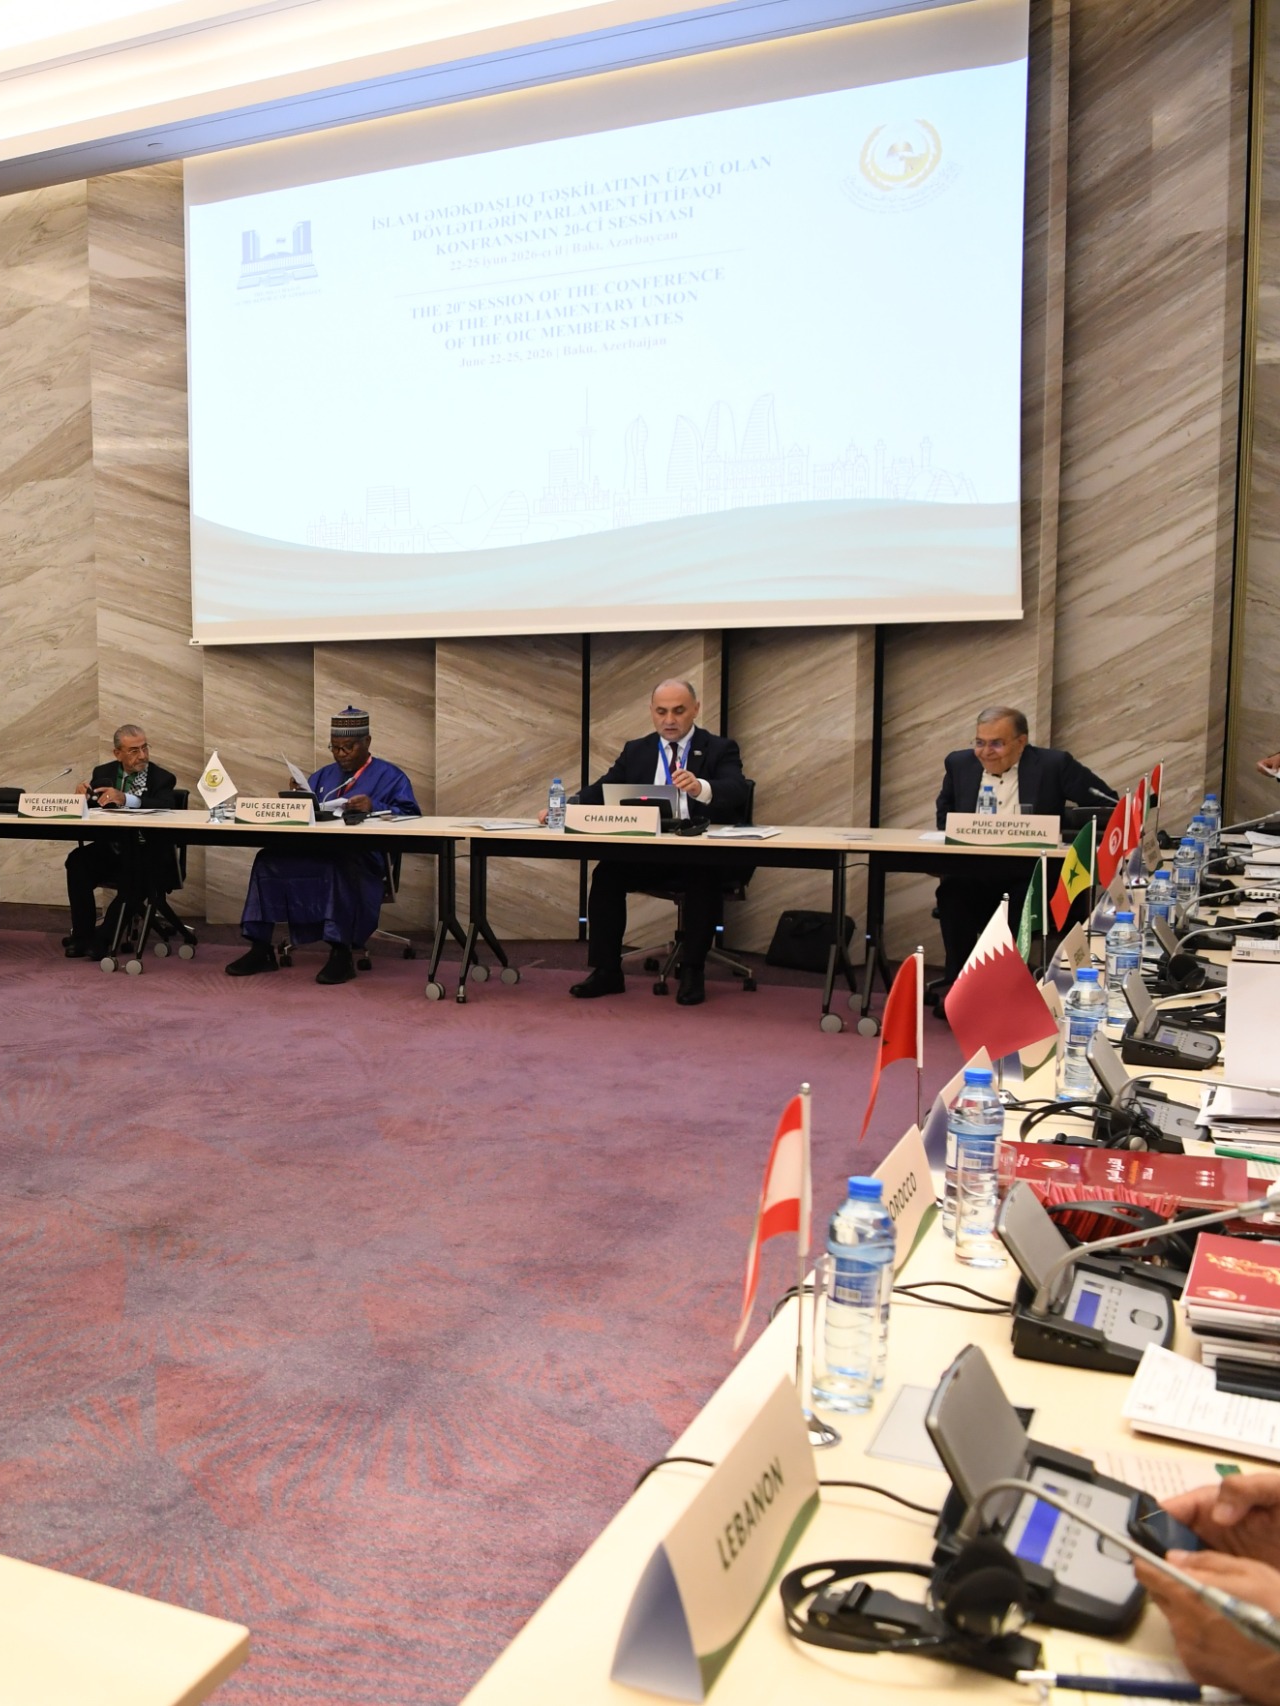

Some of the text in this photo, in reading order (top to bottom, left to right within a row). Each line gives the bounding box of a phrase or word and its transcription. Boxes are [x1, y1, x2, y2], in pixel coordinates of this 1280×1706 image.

[720, 154, 771, 175] OLAN
[534, 195, 638, 223] PARLAMENT
[436, 226, 559, 256] KONFRANSININ
[410, 304, 441, 320] THE
[468, 291, 535, 312] SESSION
[539, 287, 562, 303] OF
[567, 283, 600, 300] THE
[604, 266, 726, 295] CONFERENCE
[432, 289, 699, 335] OF THE PARLIAMENTARY UNION
[444, 310, 685, 351] OF THE OIC MEMBER STATES
[459, 356, 487, 369] June
[526, 348, 553, 361] 2026
[601, 336, 668, 353] Azerbaijan
[41, 797, 80, 805] CHAIRMAN
[255, 810, 291, 818] GENERAL
[262, 802, 307, 810] SECRETARY
[584, 814, 638, 823] CHAIRMAN
[955, 828, 1048, 837] SECRETARY GENERAL
[972, 820, 1031, 829] PUIC DEPUTY
[886, 1171, 917, 1222] OROCCO
[715, 1455, 785, 1573] LEBANON
